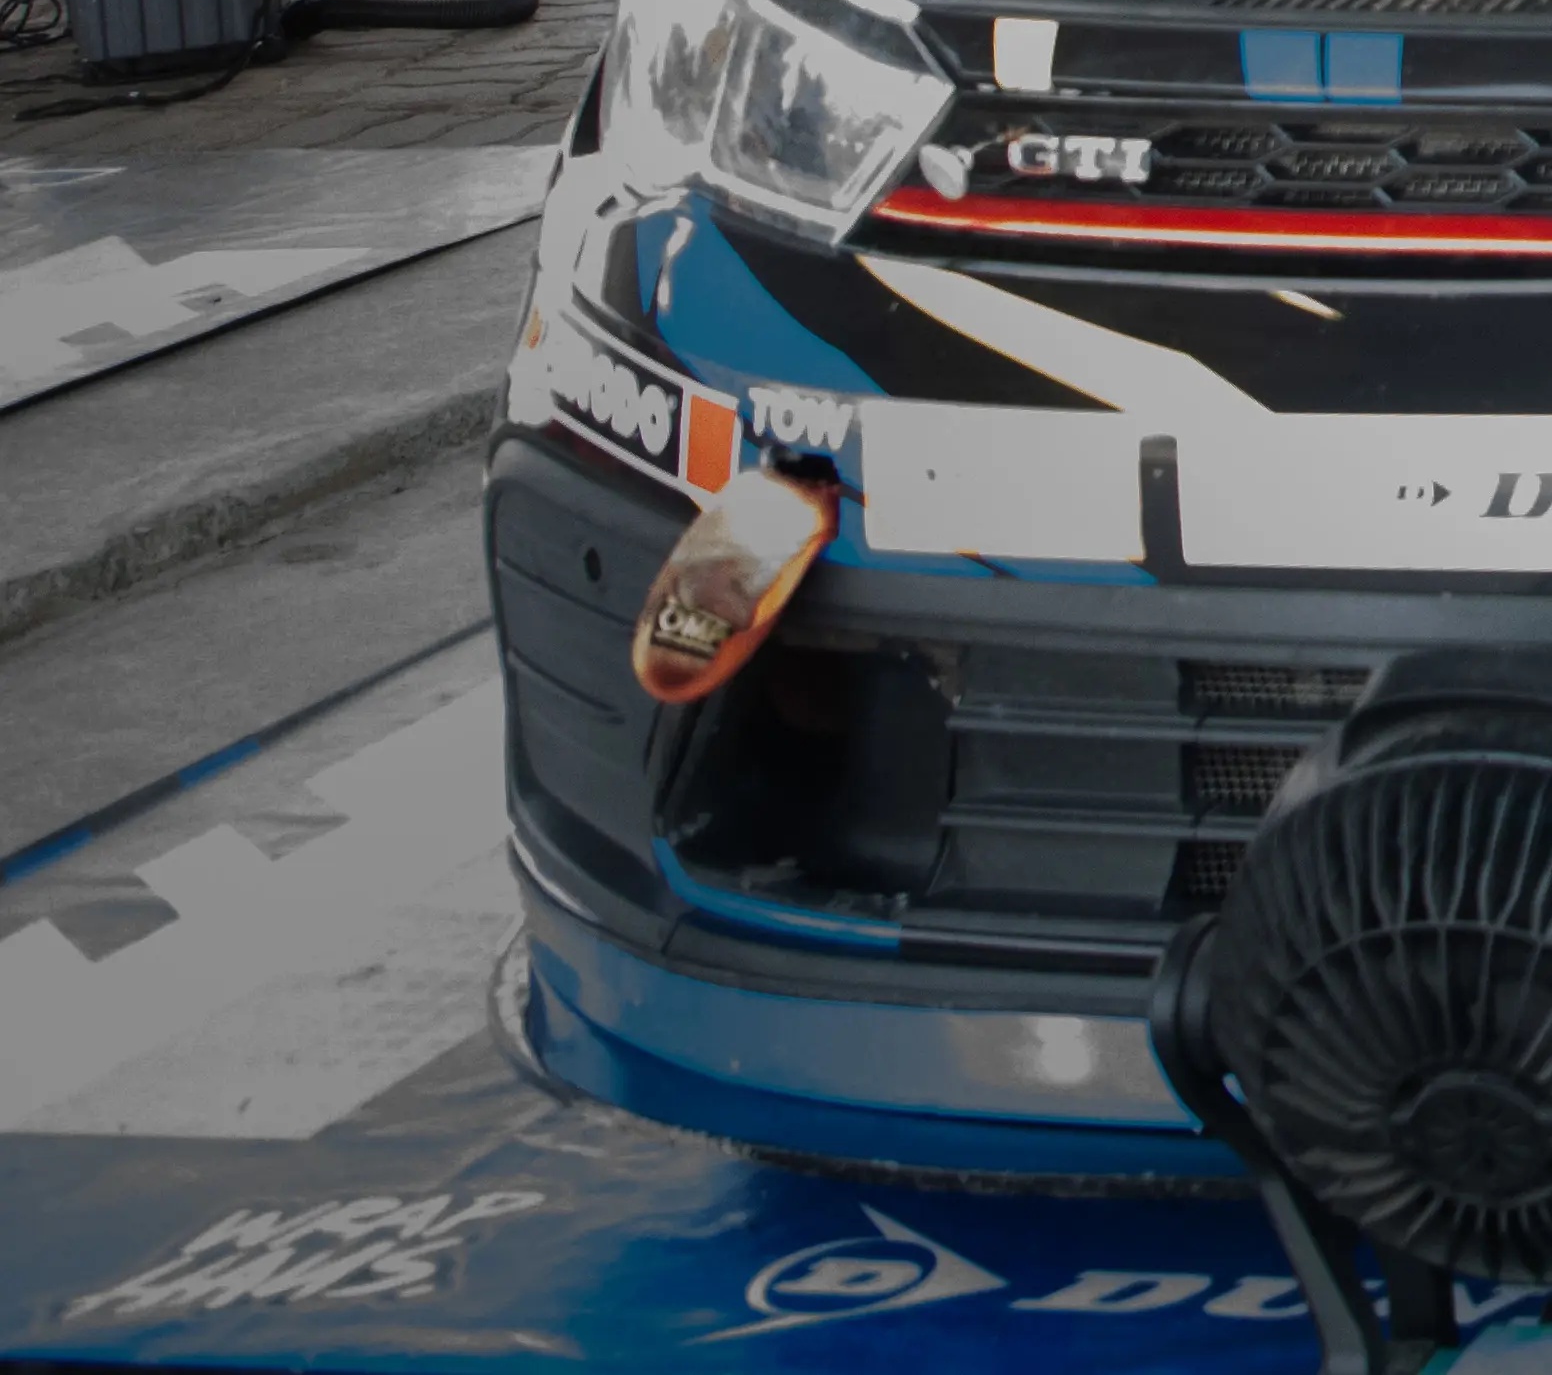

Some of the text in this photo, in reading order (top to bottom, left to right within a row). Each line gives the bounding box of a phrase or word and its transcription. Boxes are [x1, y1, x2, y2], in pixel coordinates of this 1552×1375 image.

[1007, 132, 1152, 183] GTI
[748, 386, 854, 451] TOW
[181, 1191, 546, 1256] WRAP
